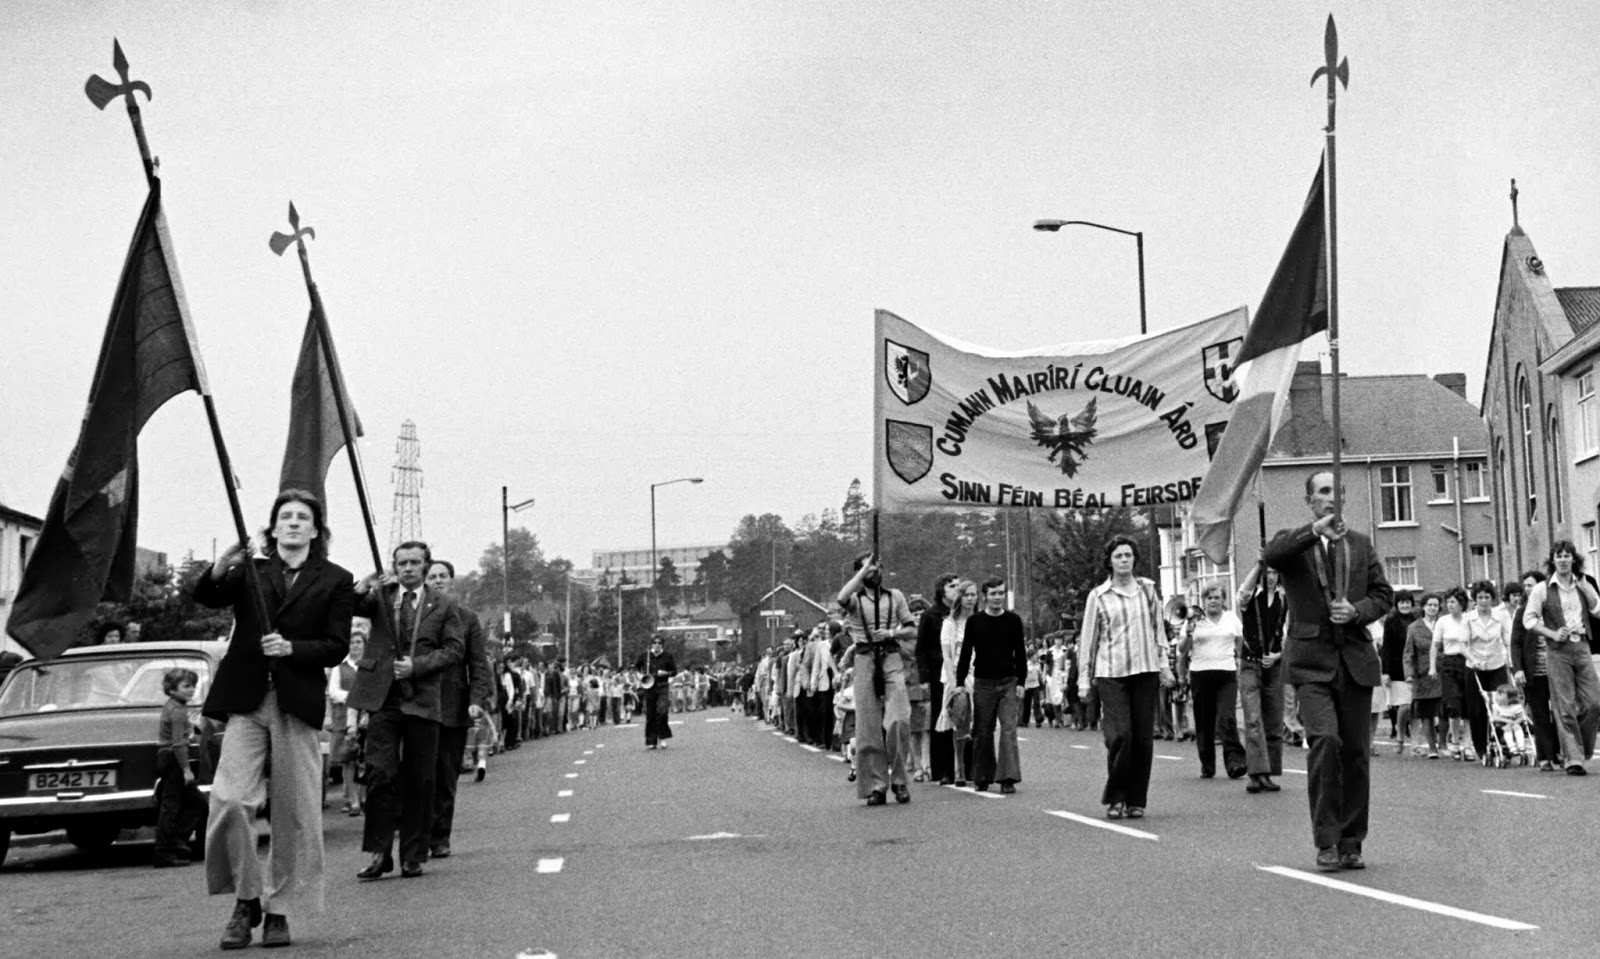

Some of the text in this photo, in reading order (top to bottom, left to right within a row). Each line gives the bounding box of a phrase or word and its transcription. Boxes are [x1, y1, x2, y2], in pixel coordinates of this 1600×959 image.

[936, 389, 995, 456] CUMANN
[1084, 366, 1165, 410] CLUAIN
[1159, 402, 1198, 450] ÁRD
[940, 472, 990, 502] SINN
[998, 482, 1043, 507] FÉIN
[1054, 488, 1113, 508] BÉAL
[87, 771, 110, 786] TZ
